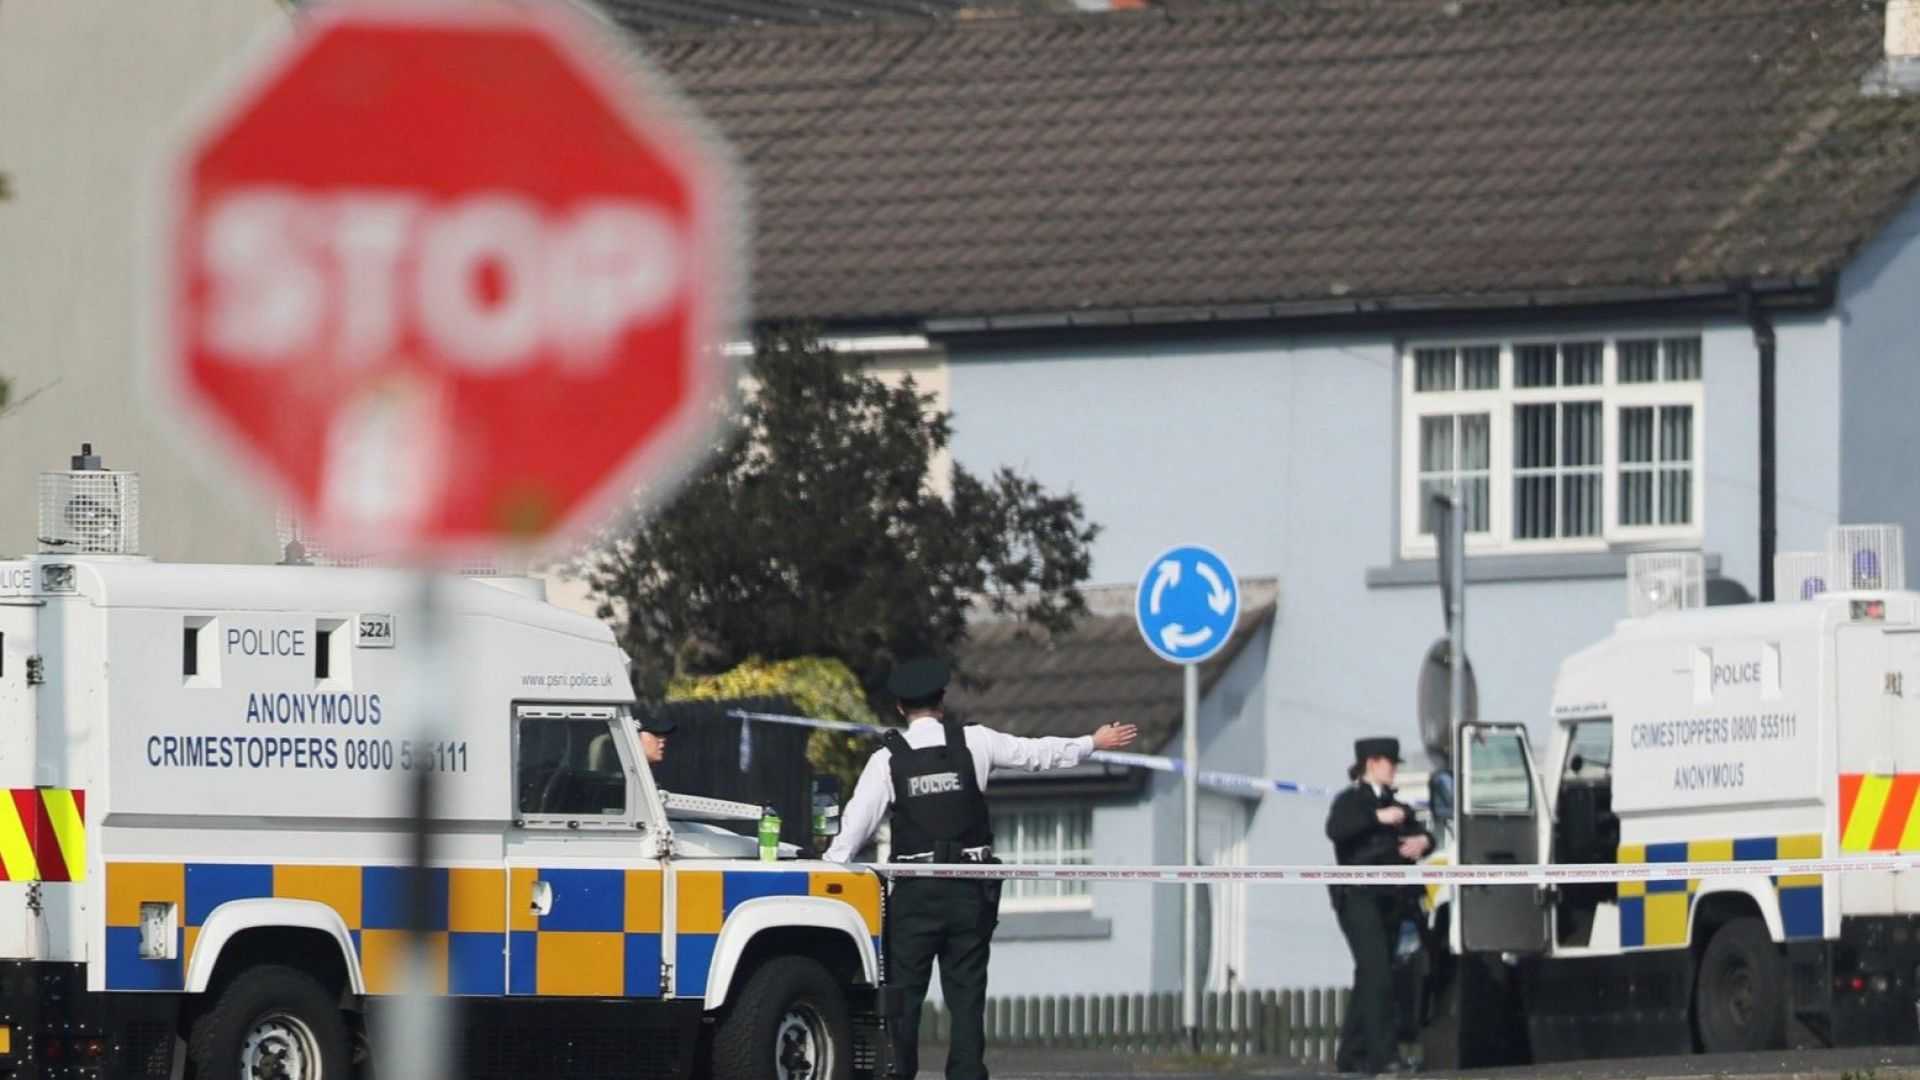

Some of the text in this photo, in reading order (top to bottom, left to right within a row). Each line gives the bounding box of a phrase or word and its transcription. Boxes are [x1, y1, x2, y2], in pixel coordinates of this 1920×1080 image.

[200, 192, 682, 372] STOP
[228, 628, 305, 656] POLICE
[521, 673, 613, 689] www.psni.police.uk
[1713, 662, 1761, 685] POLICE
[246, 693, 381, 725] ANONYMOUS
[1631, 713, 1796, 749] CRIMESTOPPERS 0800 555111
[147, 735, 467, 772] CRIMESTOPPERS 0800 55111
[909, 772, 961, 796] POLICE
[1673, 762, 1745, 790] ANONYMOUS
